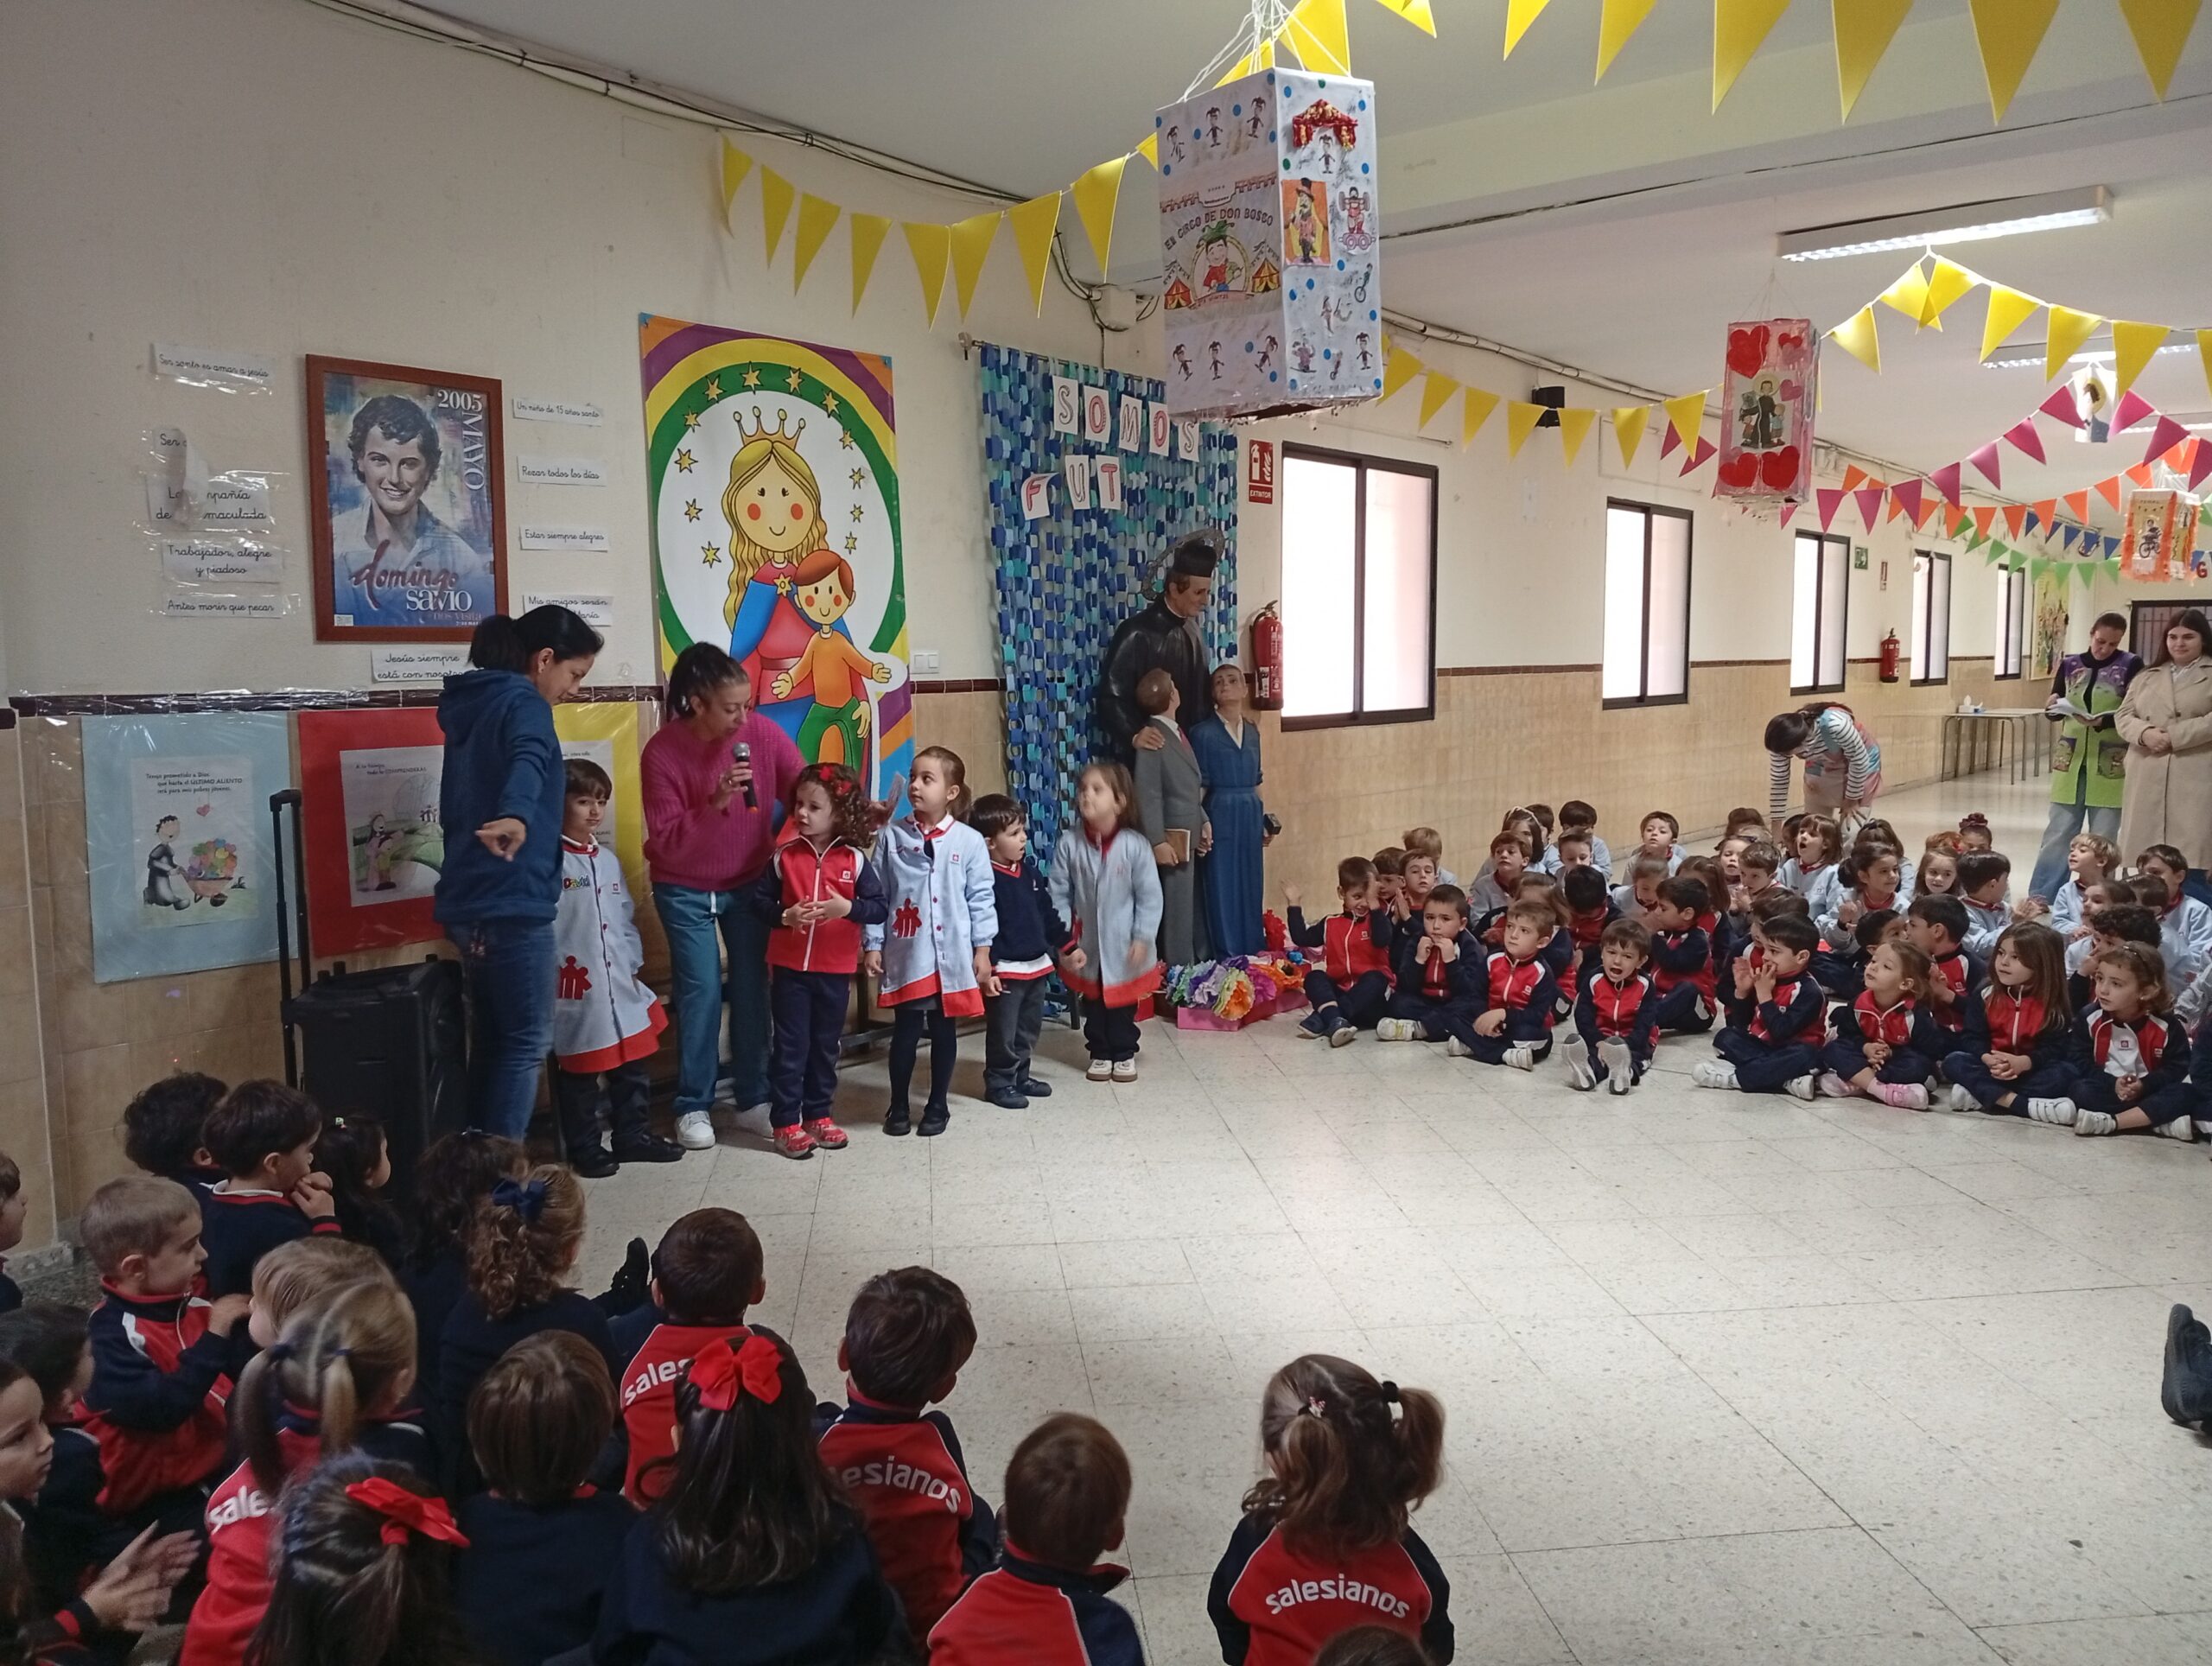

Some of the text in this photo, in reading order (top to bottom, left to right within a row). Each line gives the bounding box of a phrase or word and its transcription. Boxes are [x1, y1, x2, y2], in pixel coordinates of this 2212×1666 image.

[1178, 217, 1202, 238] CIRCO
[1205, 211, 1217, 224] DE
[1244, 208, 1274, 226] BOSCO
[159, 353, 173, 366] Ser
[213, 366, 238, 374] amar
[437, 389, 483, 412] 2005
[556, 405, 563, 415] 15
[1058, 385, 1195, 453] SOMOS
[160, 433, 180, 447] Ser
[462, 411, 485, 491] MAYO
[547, 467, 569, 478] todos
[570, 468, 582, 479] los
[583, 470, 601, 480] días
[1027, 462, 1119, 512] FUT
[1249, 489, 1272, 499] EXTINTOR
[156, 508, 172, 519] de
[525, 529, 605, 544] Estar siempre alegres
[168, 545, 271, 561] Trabajador, alegre
[195, 564, 248, 577] y piadoso
[353, 541, 461, 611] domingo
[168, 600, 196, 611] Antes
[229, 604, 246, 614] que
[248, 604, 274, 615] pecar
[529, 596, 544, 605] Mis
[546, 599, 579, 607] amigos
[385, 653, 460, 666] Jesús siempre
[378, 671, 400, 679] está
[1266, 1574, 1410, 1618] salesianos
